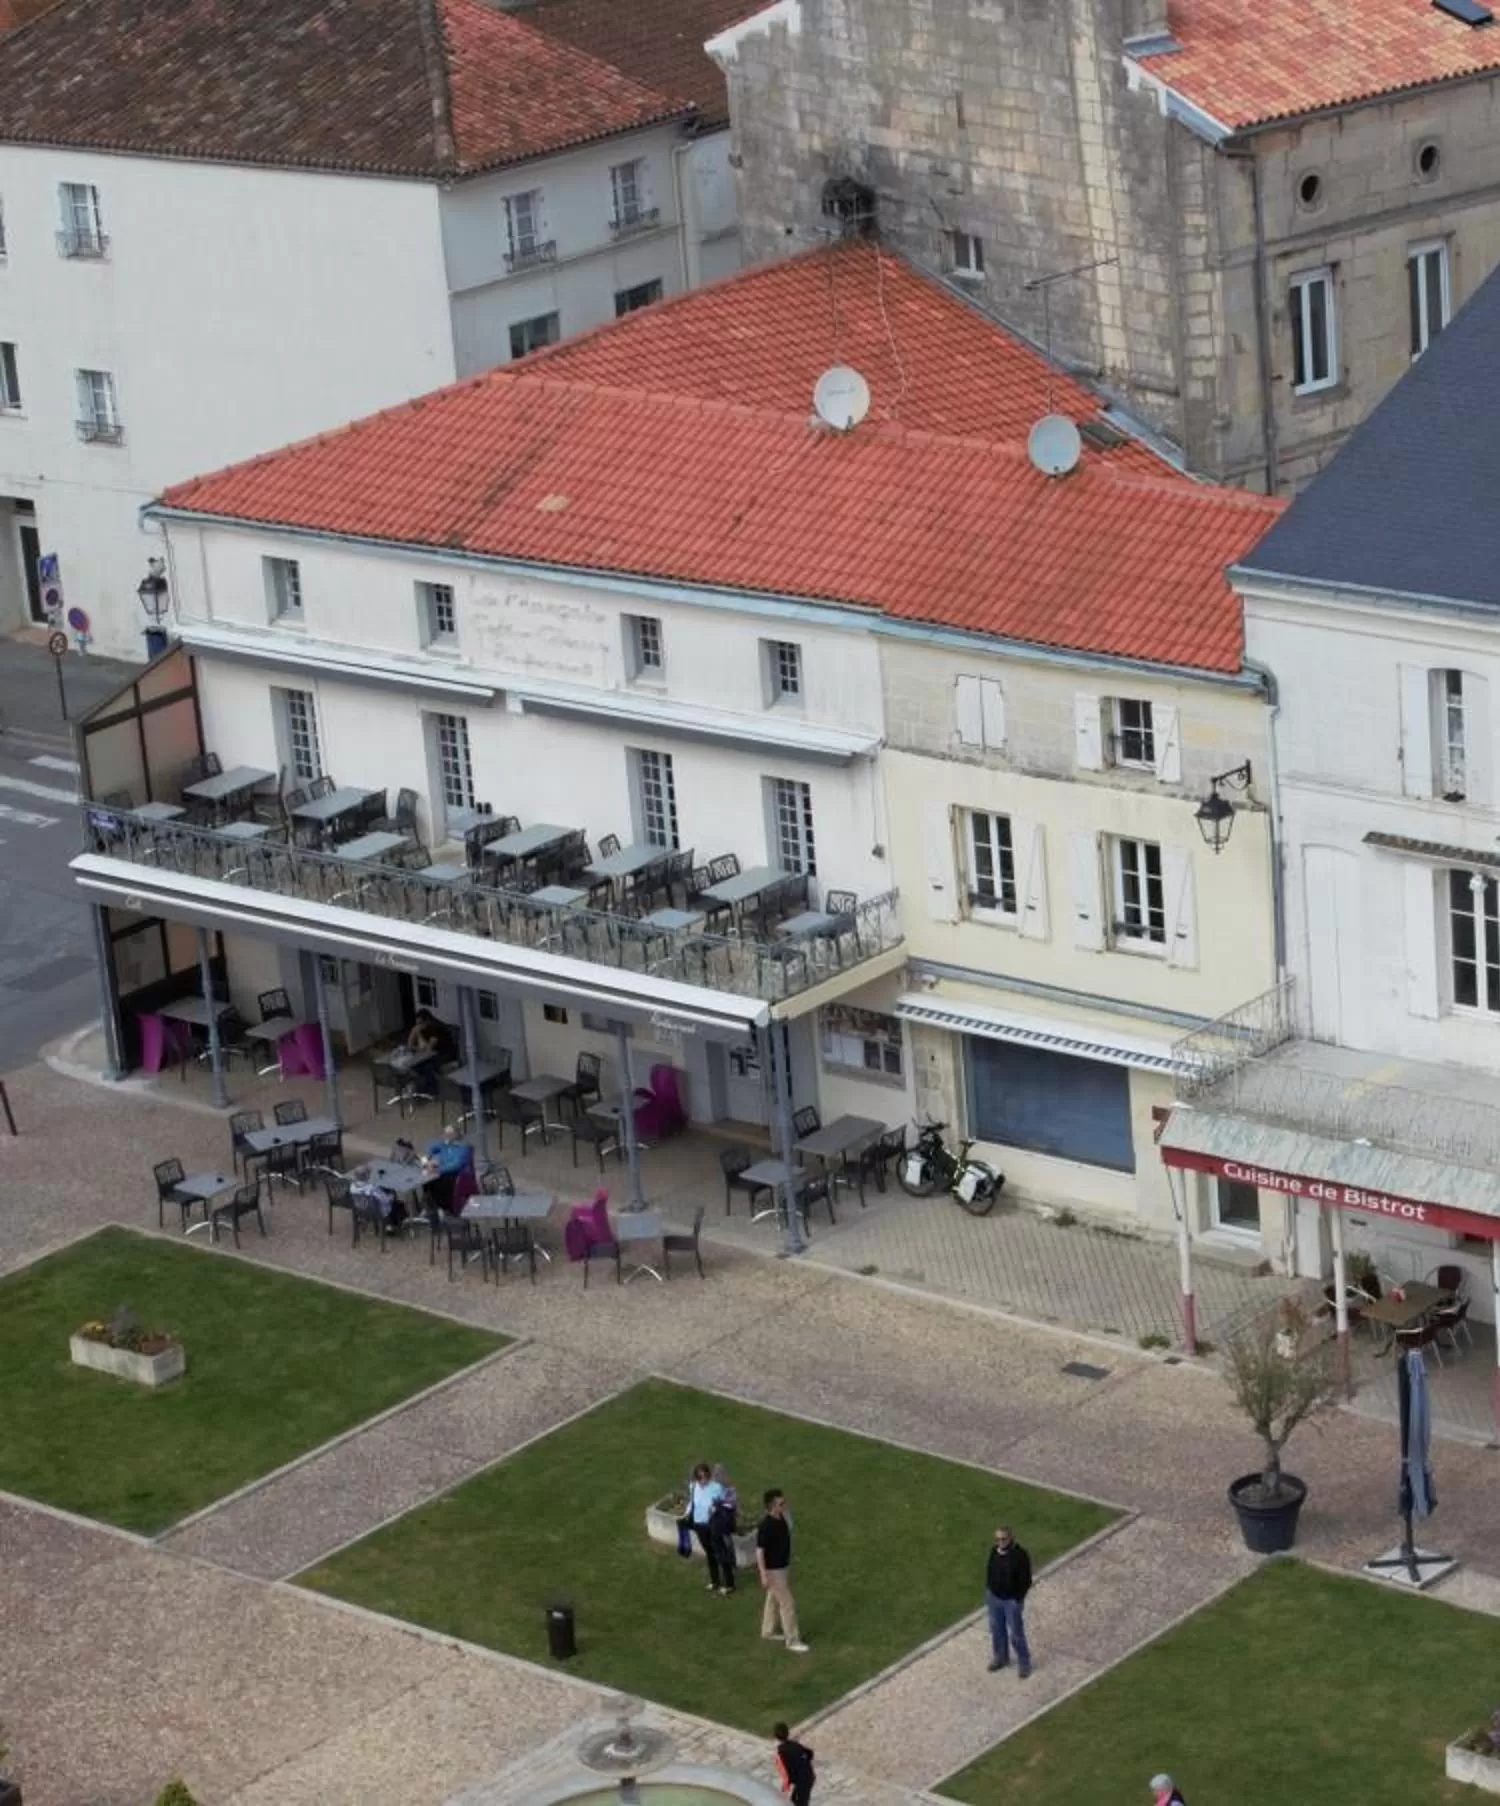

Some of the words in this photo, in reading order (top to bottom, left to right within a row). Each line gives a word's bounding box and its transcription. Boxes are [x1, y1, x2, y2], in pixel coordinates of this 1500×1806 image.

[1223, 1162, 1302, 1192] Cuisine
[1309, 1182, 1338, 1201] de
[1344, 1188, 1426, 1221] Bistrot
